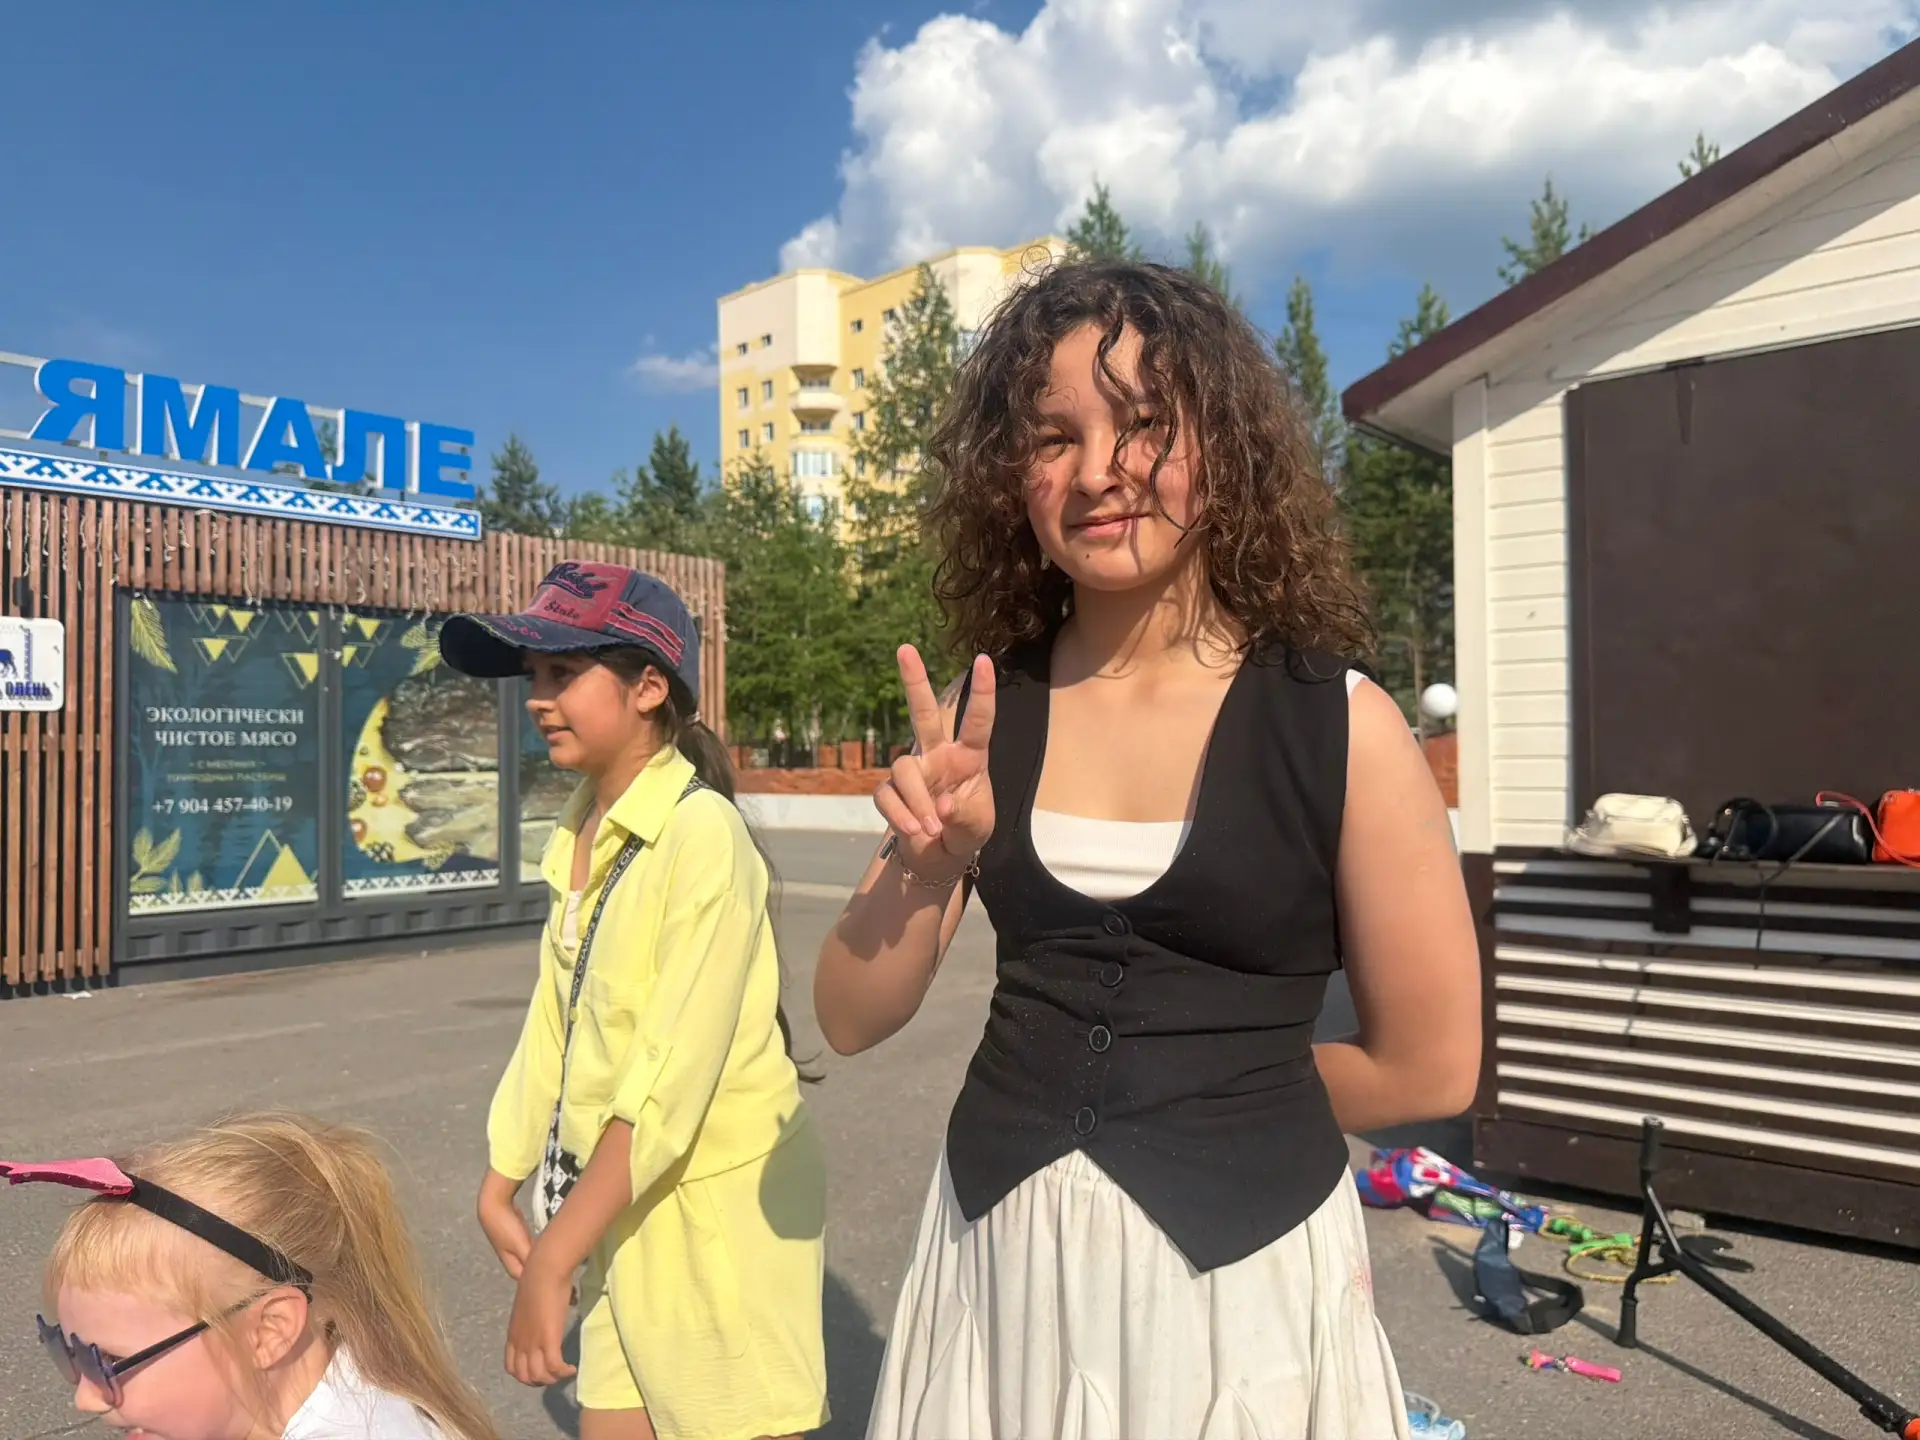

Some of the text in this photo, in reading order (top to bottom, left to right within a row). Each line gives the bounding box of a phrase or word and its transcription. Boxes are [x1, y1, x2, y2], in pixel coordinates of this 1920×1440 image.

[28, 358, 476, 499] ЯМАЛЕ
[146, 707, 304, 724] ЭКОЛОГИЧЕСКИ
[155, 731, 297, 746] ЧИСТОЕ МЯСО
[152, 796, 293, 814] +7 904 457-40-19
